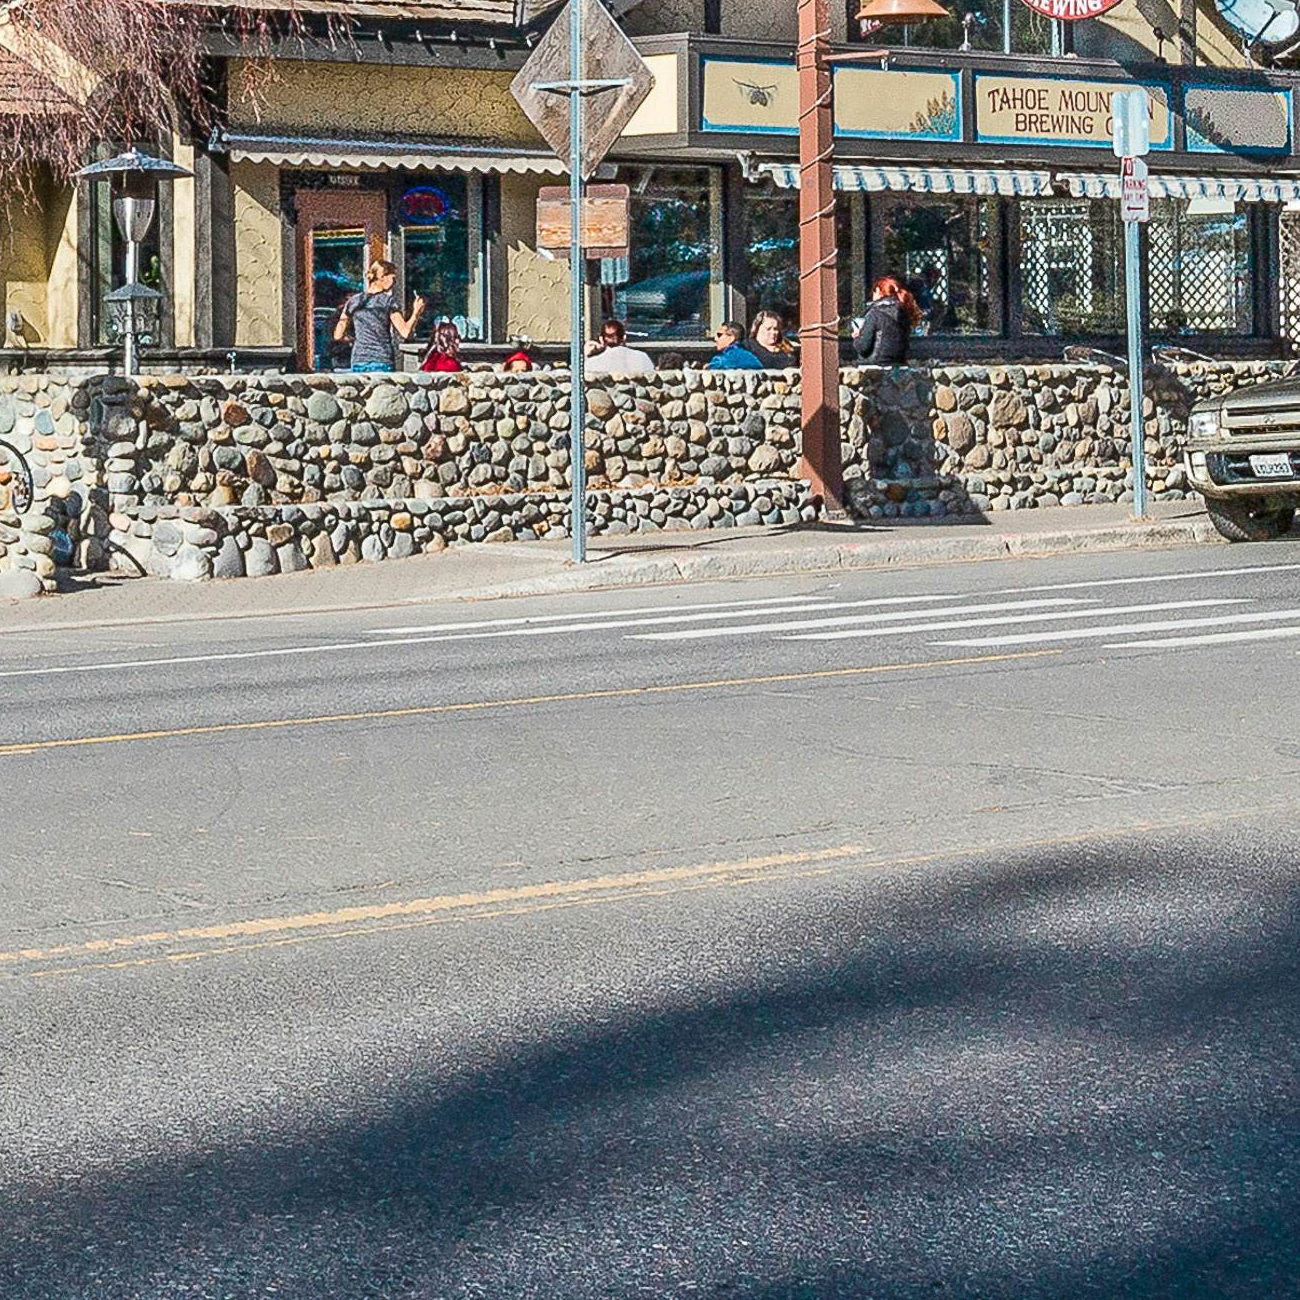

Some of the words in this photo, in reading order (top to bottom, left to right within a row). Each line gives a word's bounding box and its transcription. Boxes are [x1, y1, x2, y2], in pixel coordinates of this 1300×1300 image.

[988, 87, 1050, 114] TAHOE
[1015, 113, 1094, 134] BREWING
[1105, 116, 1113, 136] C
